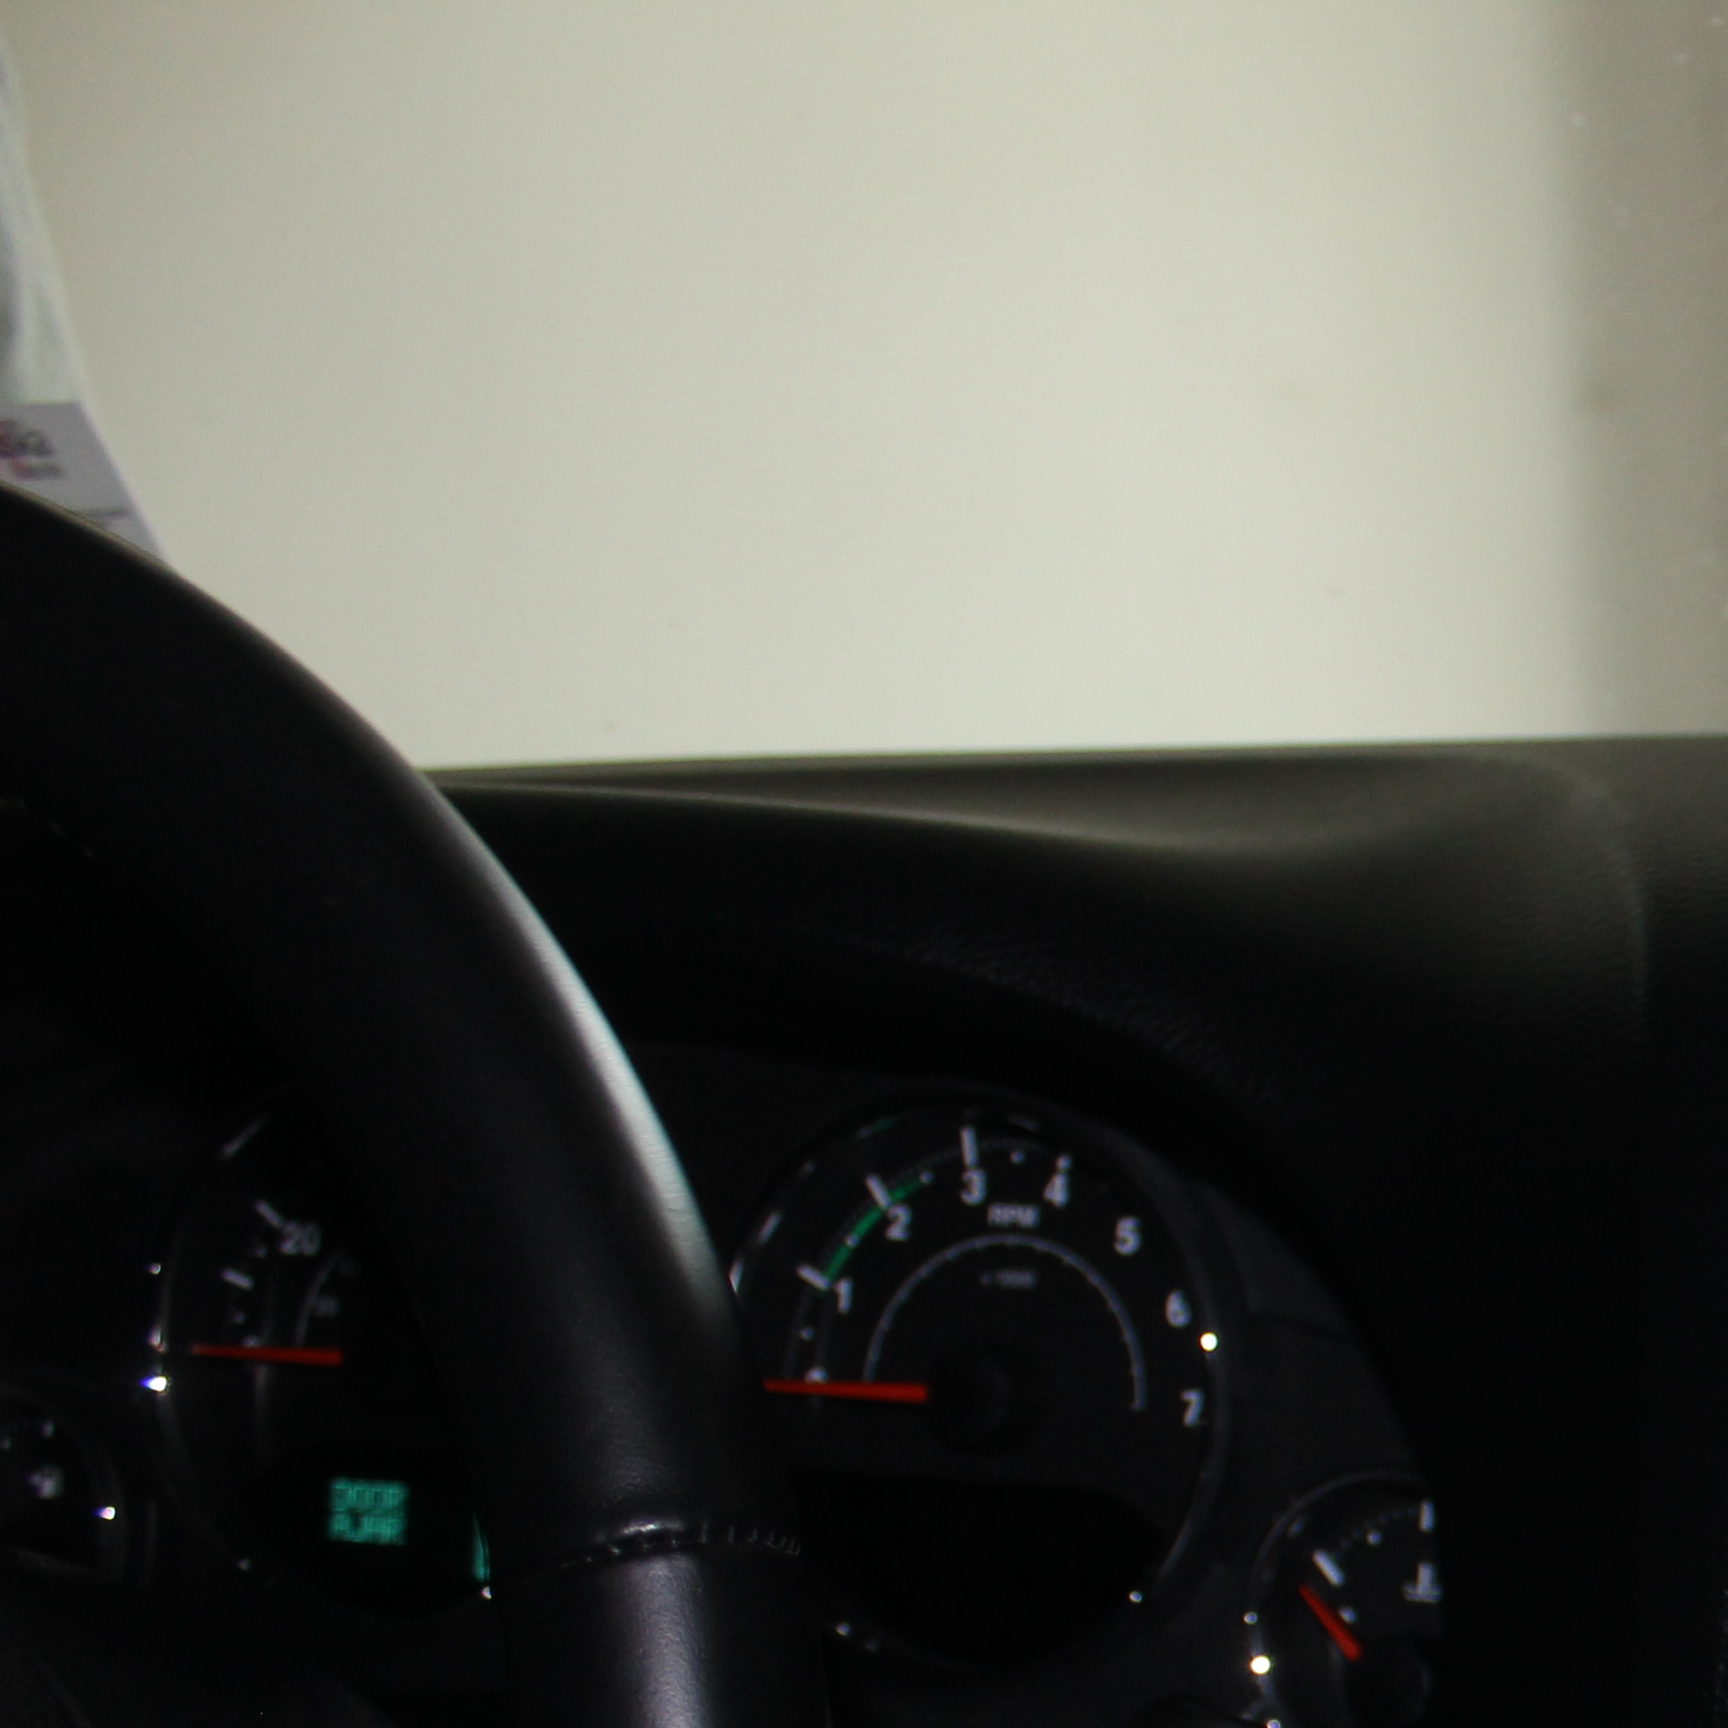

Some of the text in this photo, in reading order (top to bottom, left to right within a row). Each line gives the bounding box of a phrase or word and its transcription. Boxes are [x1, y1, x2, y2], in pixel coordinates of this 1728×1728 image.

[961, 1167, 987, 1206] 3
[884, 1203, 912, 1241] 2
[1113, 1215, 1142, 1257] 5
[834, 1278, 853, 1313] 1
[1181, 1388, 1204, 1427] 7
